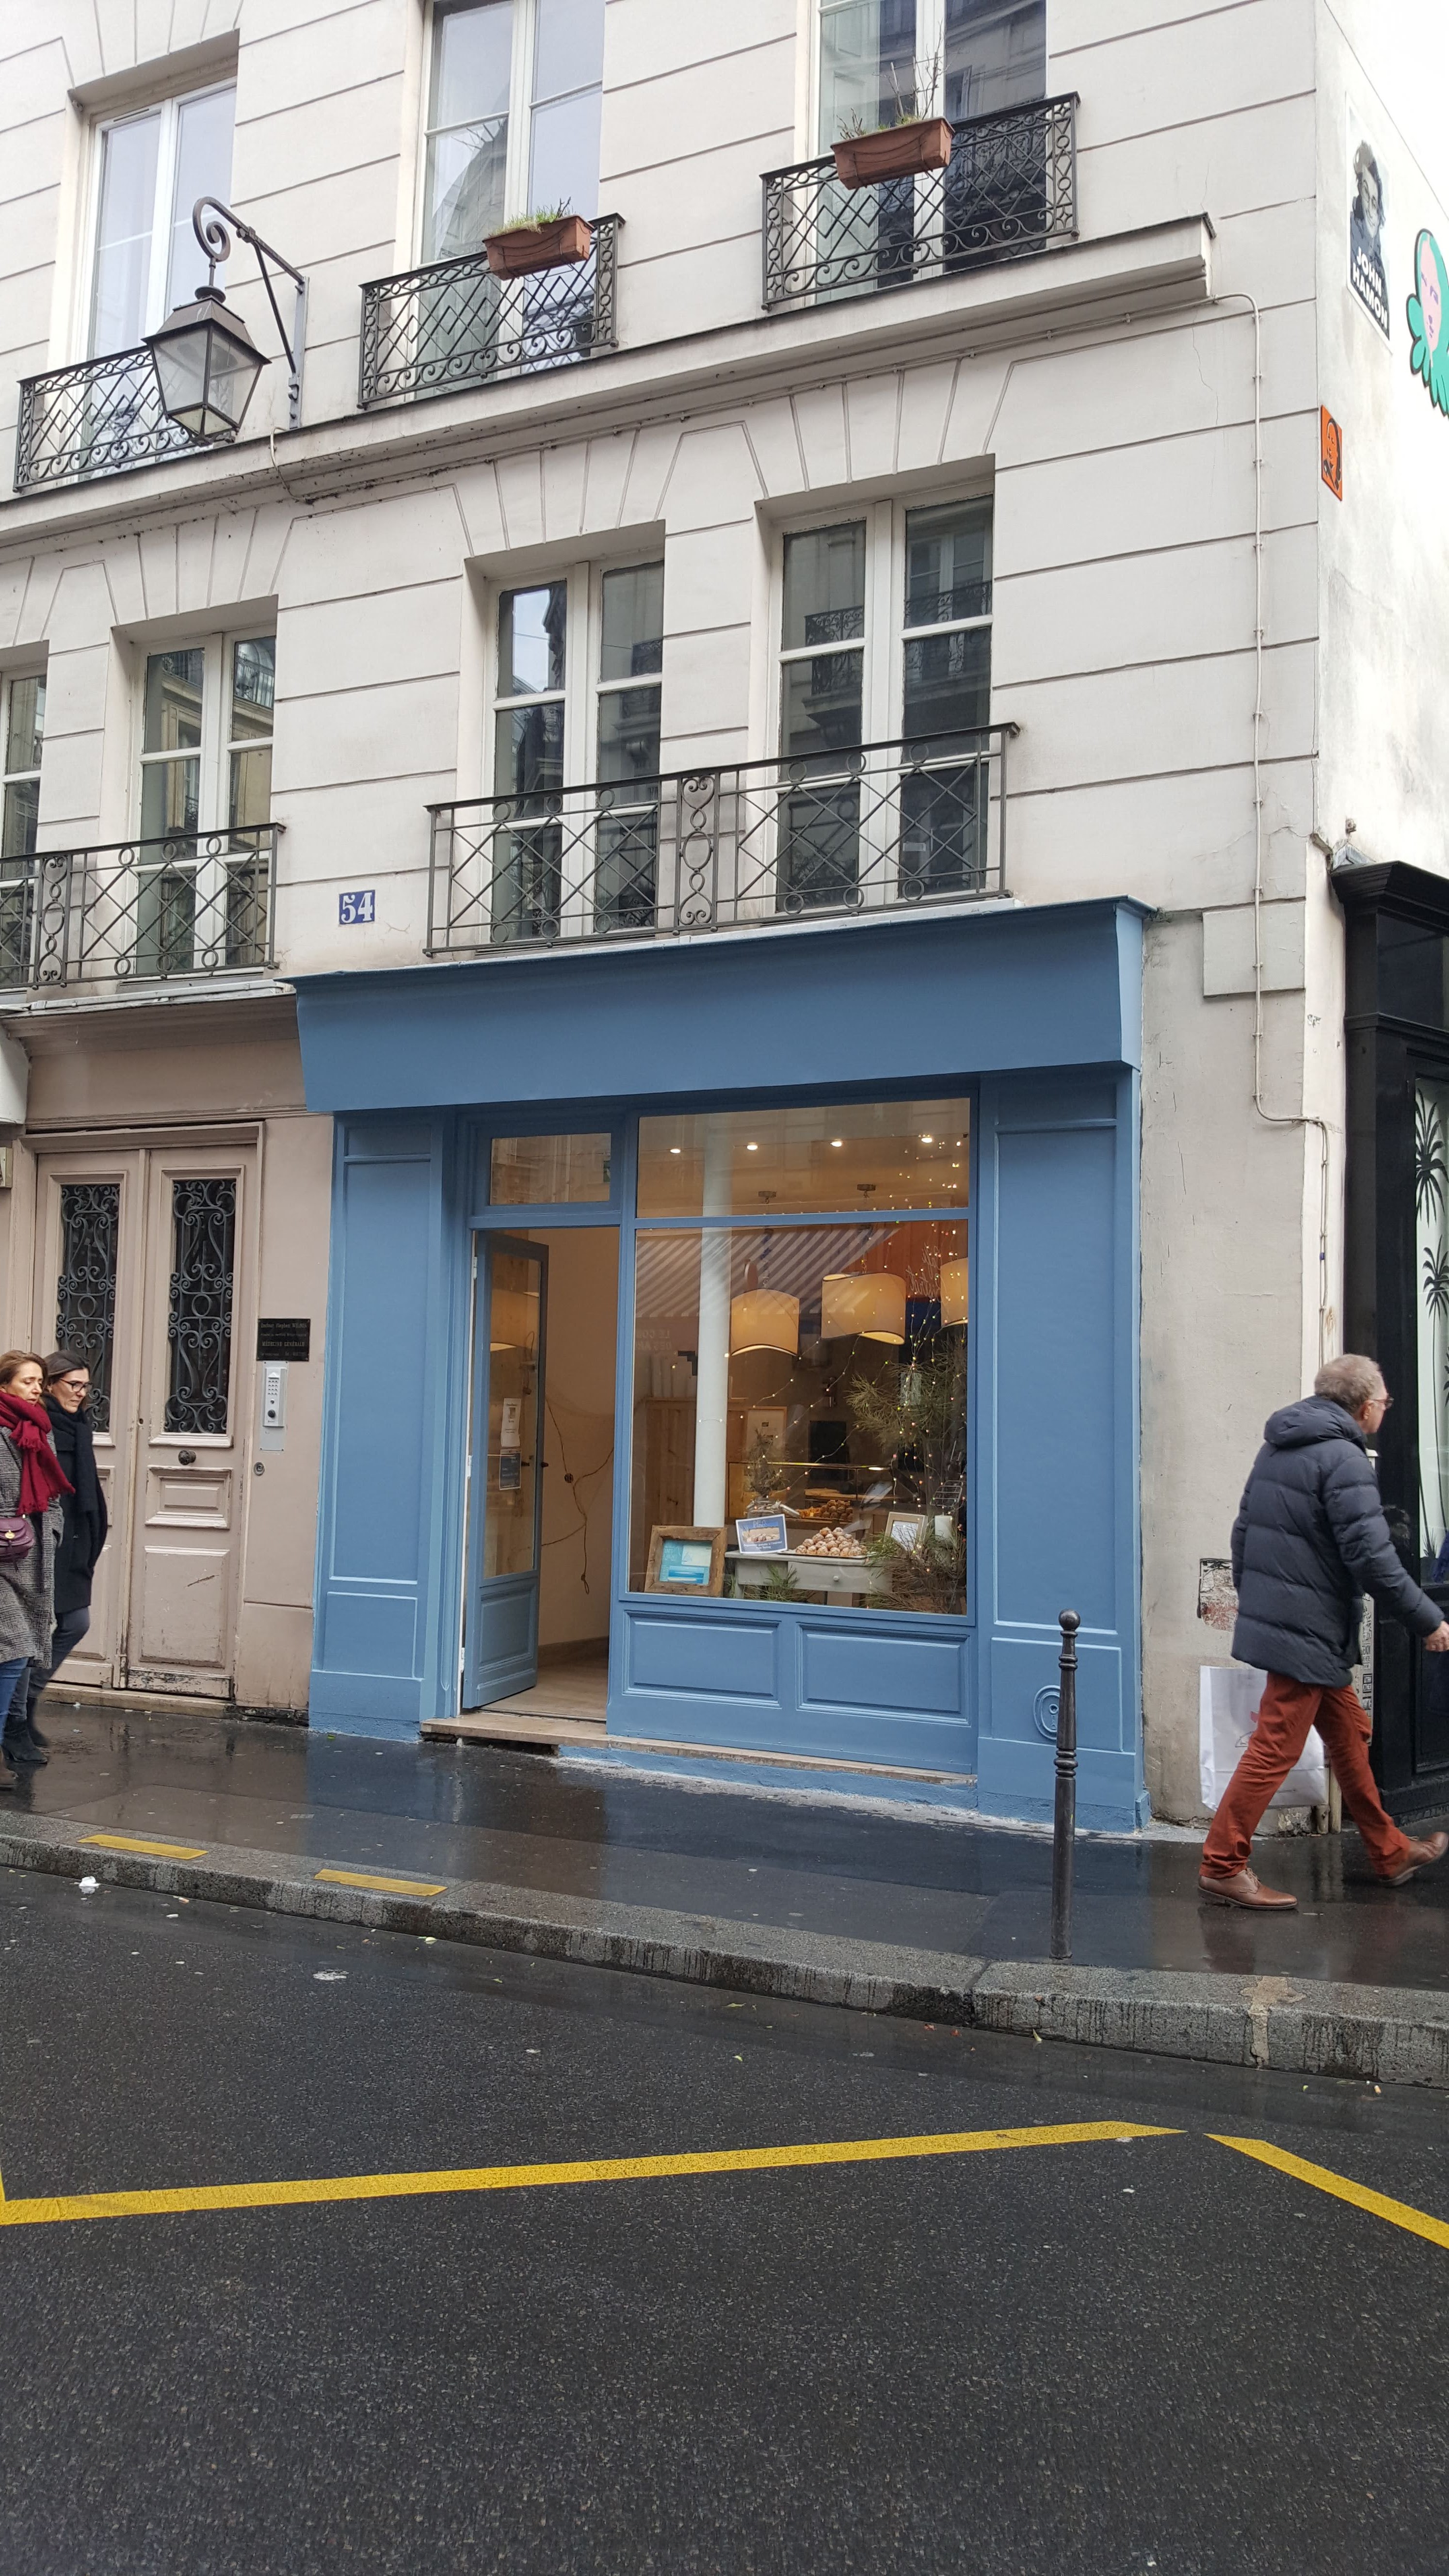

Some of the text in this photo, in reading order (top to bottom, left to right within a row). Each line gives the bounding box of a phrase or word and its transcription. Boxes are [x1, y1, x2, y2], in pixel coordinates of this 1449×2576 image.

[1352, 262, 1387, 330] HAMON
[1356, 246, 1382, 298] JOHN
[341, 892, 373, 923] 54
